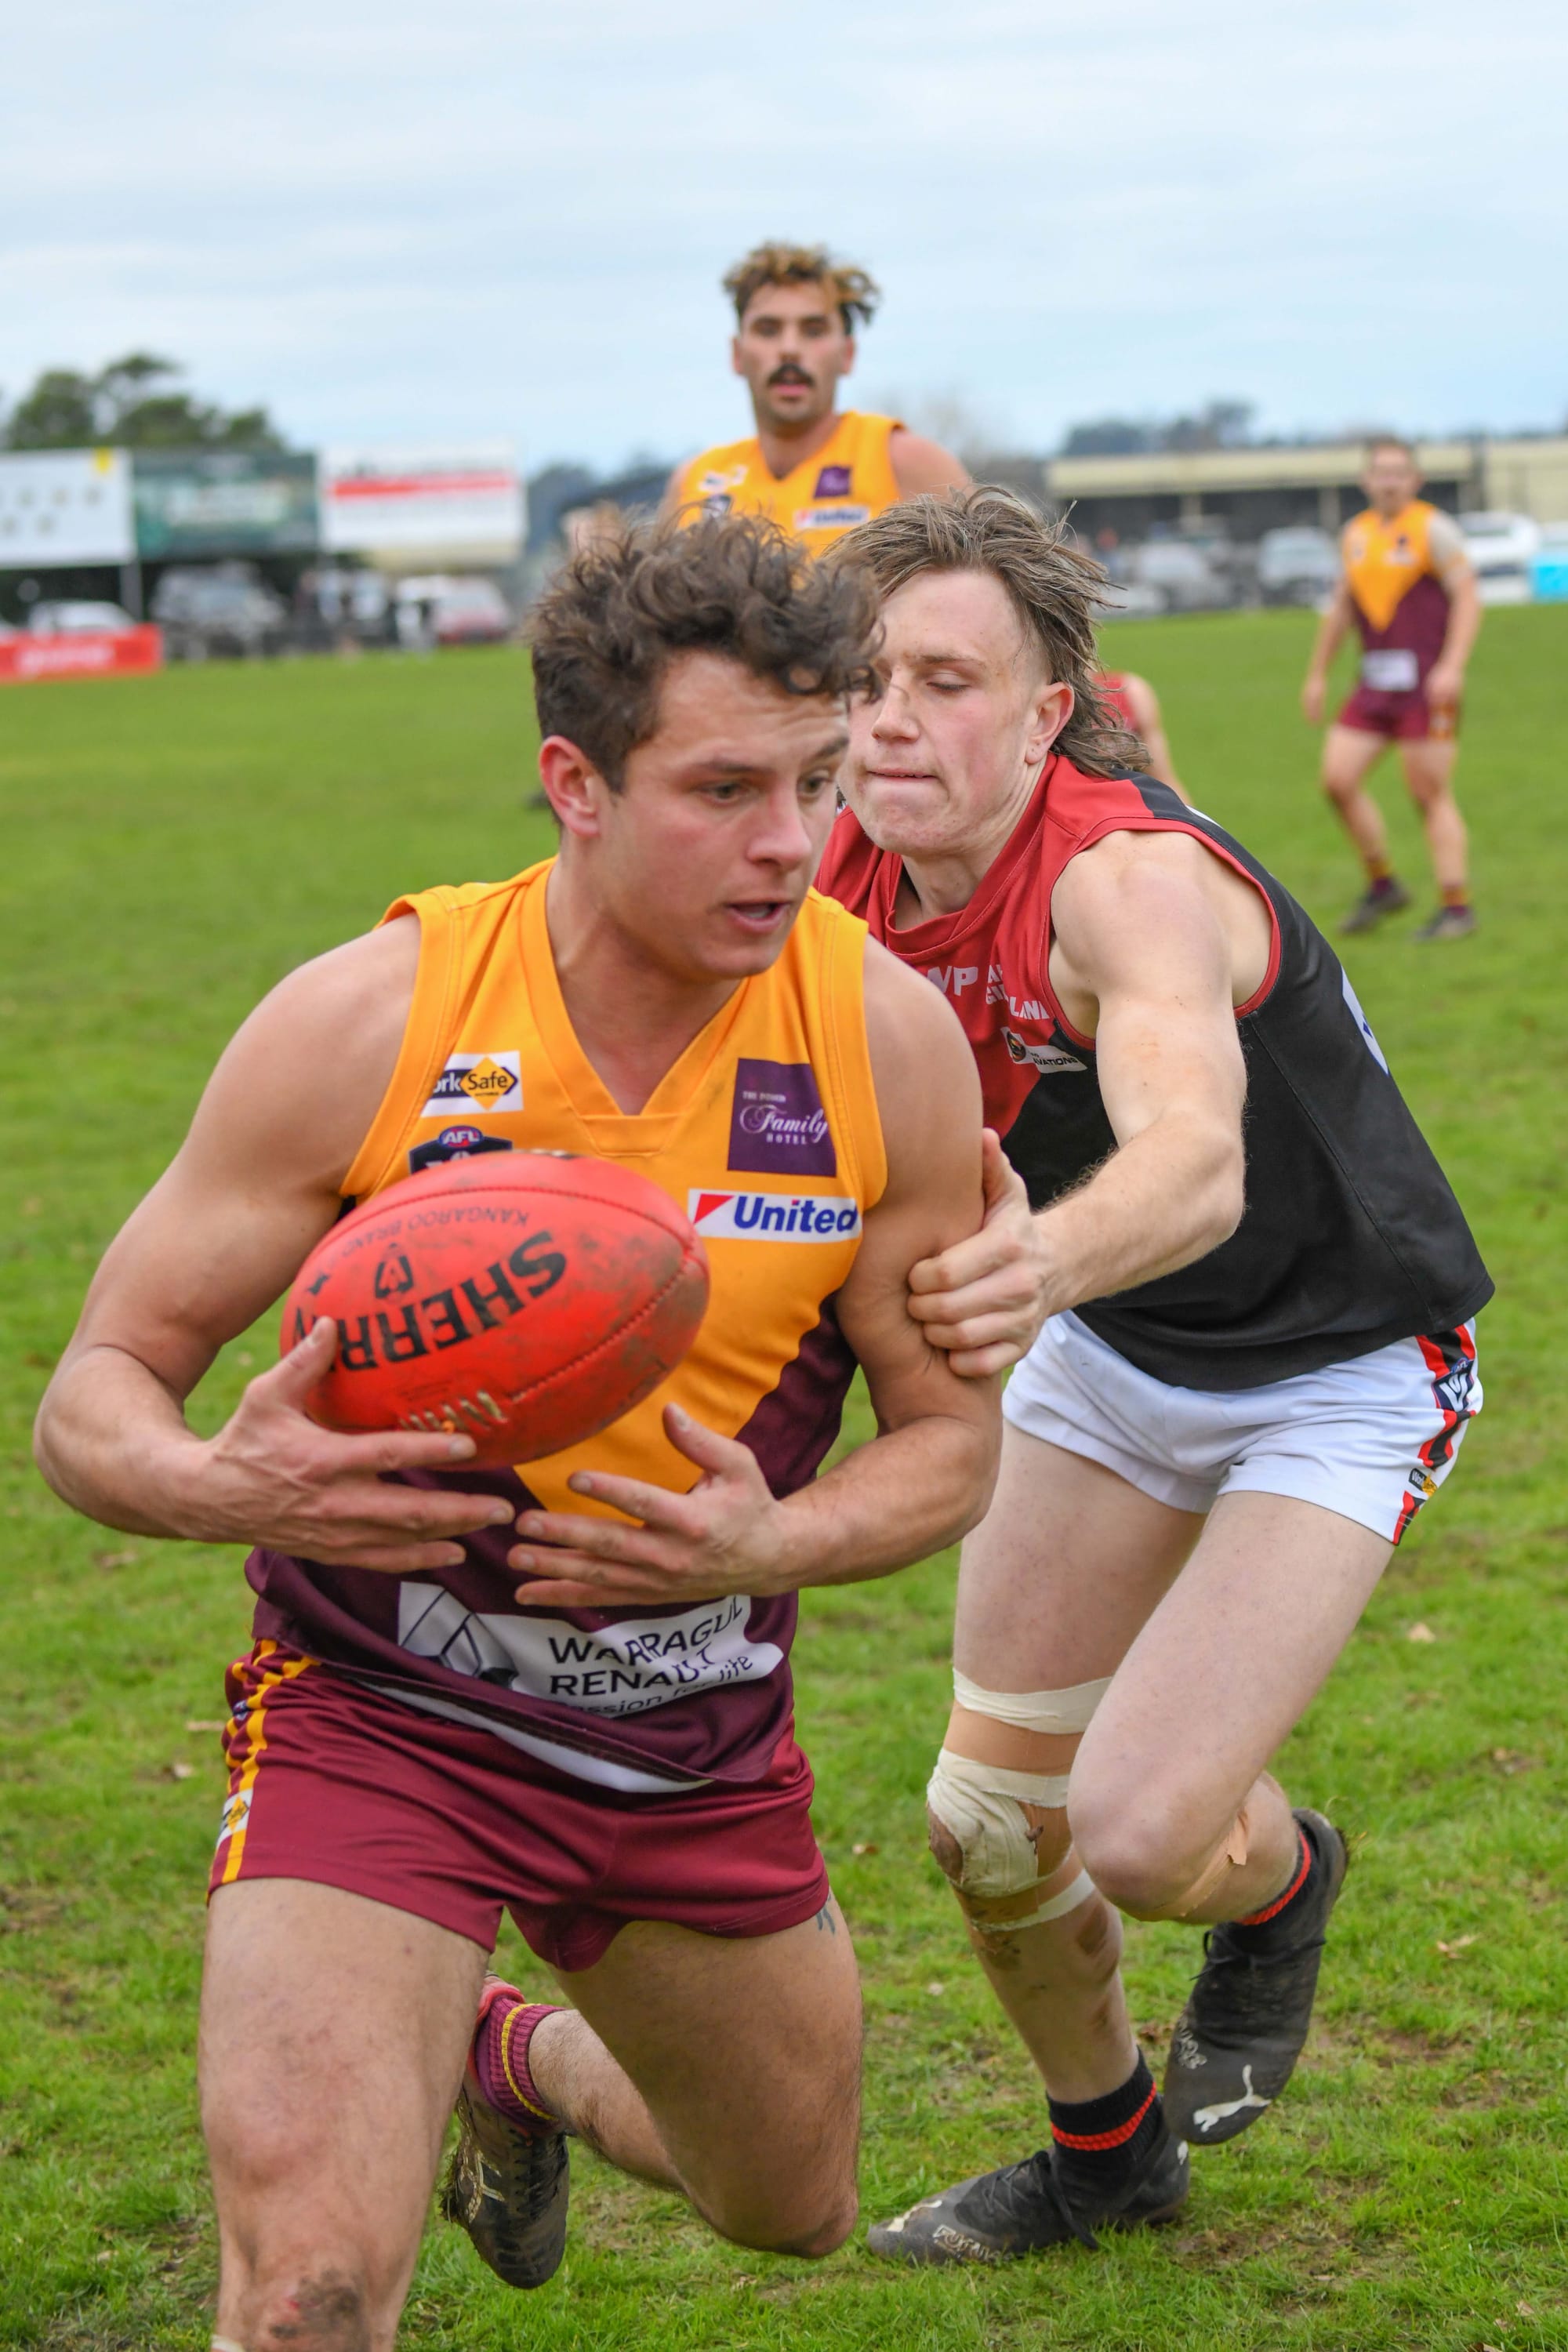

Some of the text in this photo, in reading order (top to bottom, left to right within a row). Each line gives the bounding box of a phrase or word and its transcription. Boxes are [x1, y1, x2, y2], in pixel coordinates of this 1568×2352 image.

[433, 1071, 508, 1093] orkSafe
[739, 1104, 828, 1143] Family
[442, 1130, 481, 1145] AFL
[766, 1133, 808, 1145] HOTEL
[408, 1206, 529, 1230] KANGAROO
[733, 1196, 858, 1233] United
